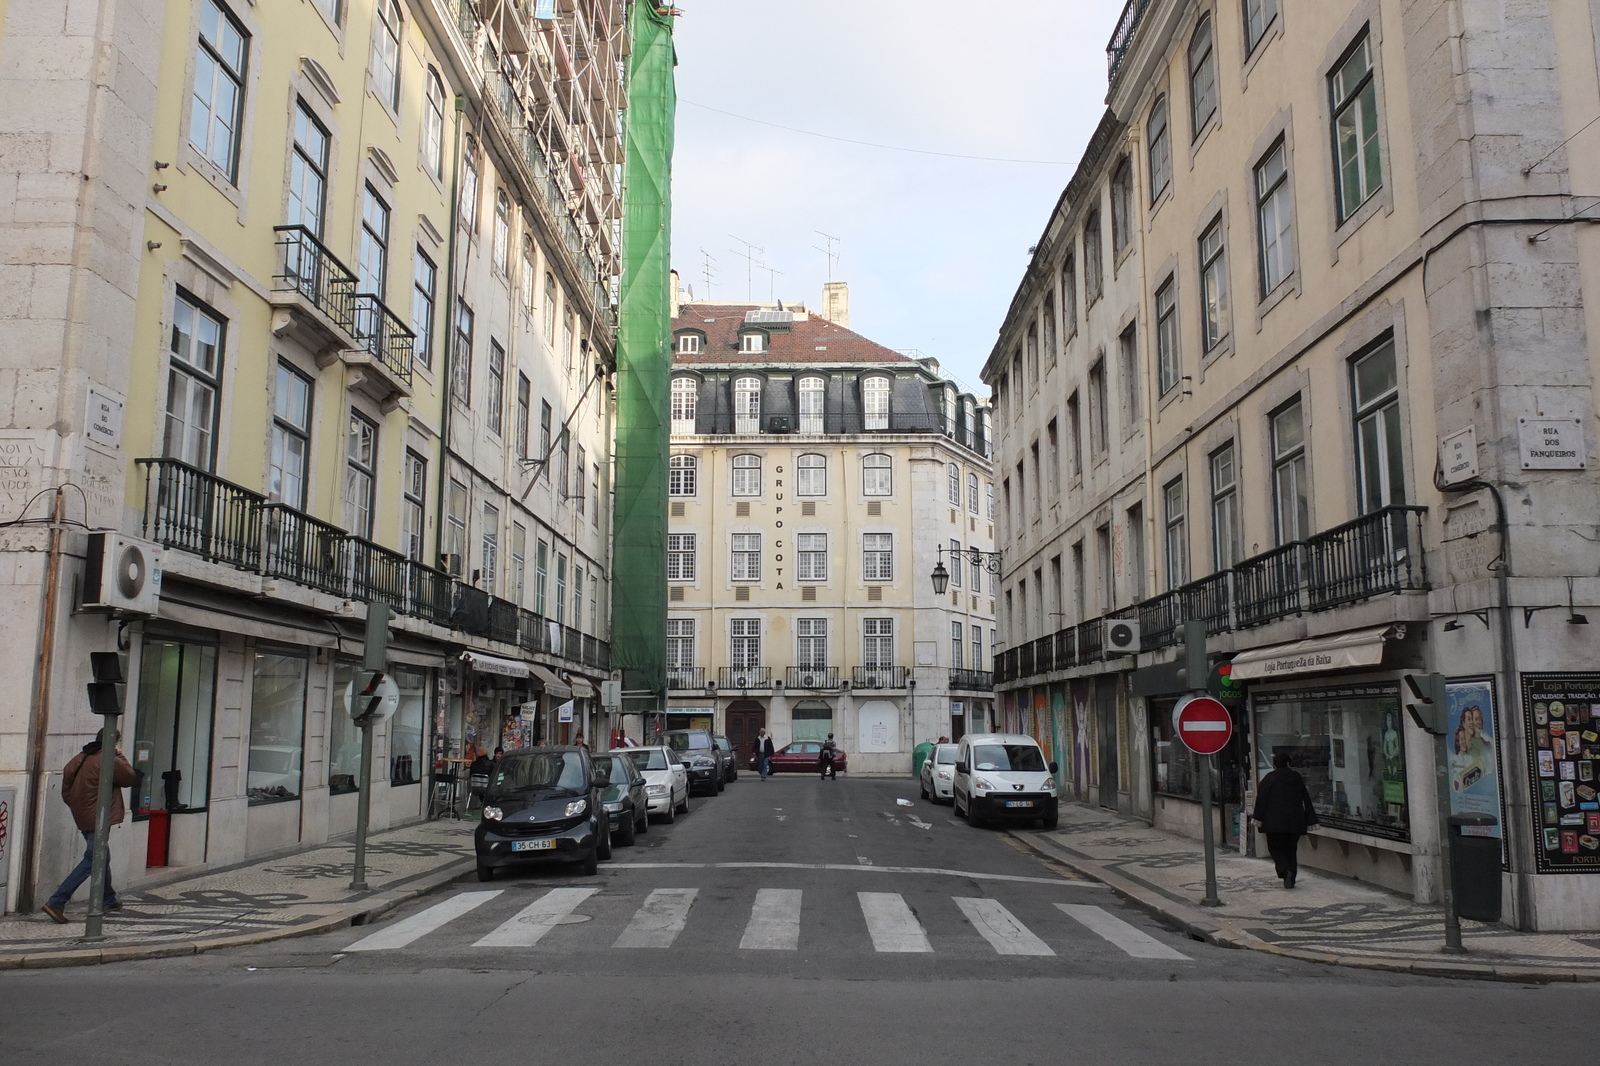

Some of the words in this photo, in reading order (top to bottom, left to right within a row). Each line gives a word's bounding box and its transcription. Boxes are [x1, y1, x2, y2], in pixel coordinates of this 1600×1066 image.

[1530, 450, 1576, 458] FANQUEIROS
[775, 466, 783, 528] GRUPO
[775, 540, 783, 590] COTA
[1264, 662, 1275, 674] Loja
[1277, 657, 1306, 672] PortugueZa
[1308, 656, 1314, 666] da
[1316, 654, 1331, 665] Baixa
[1543, 682, 1562, 692] Loja
[1219, 691, 1242, 699] JOGOS
